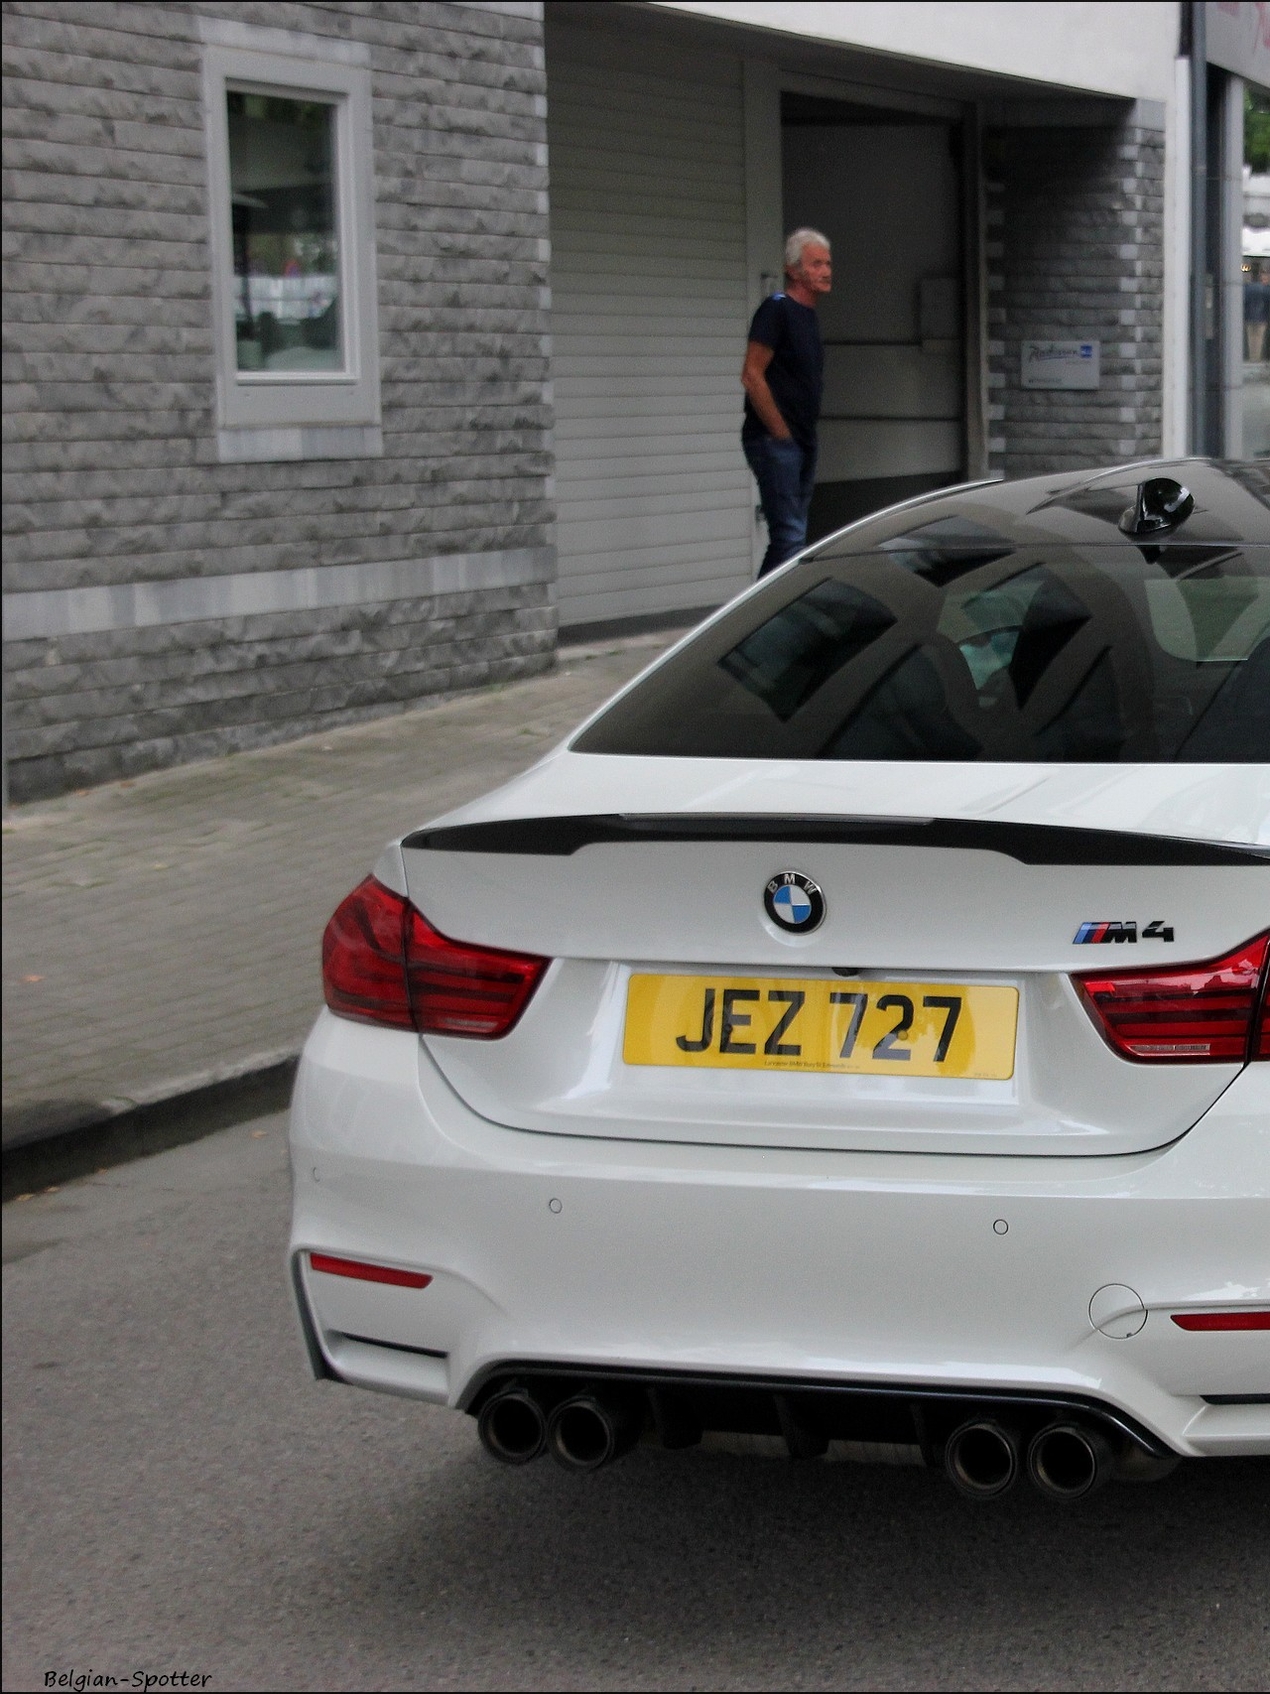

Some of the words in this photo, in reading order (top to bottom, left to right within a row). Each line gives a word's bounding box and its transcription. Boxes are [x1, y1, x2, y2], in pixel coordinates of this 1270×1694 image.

[767, 873, 817, 895] BMW
[1098, 920, 1174, 944] M4
[676, 988, 805, 1055] JEZ
[830, 991, 962, 1063] 727
